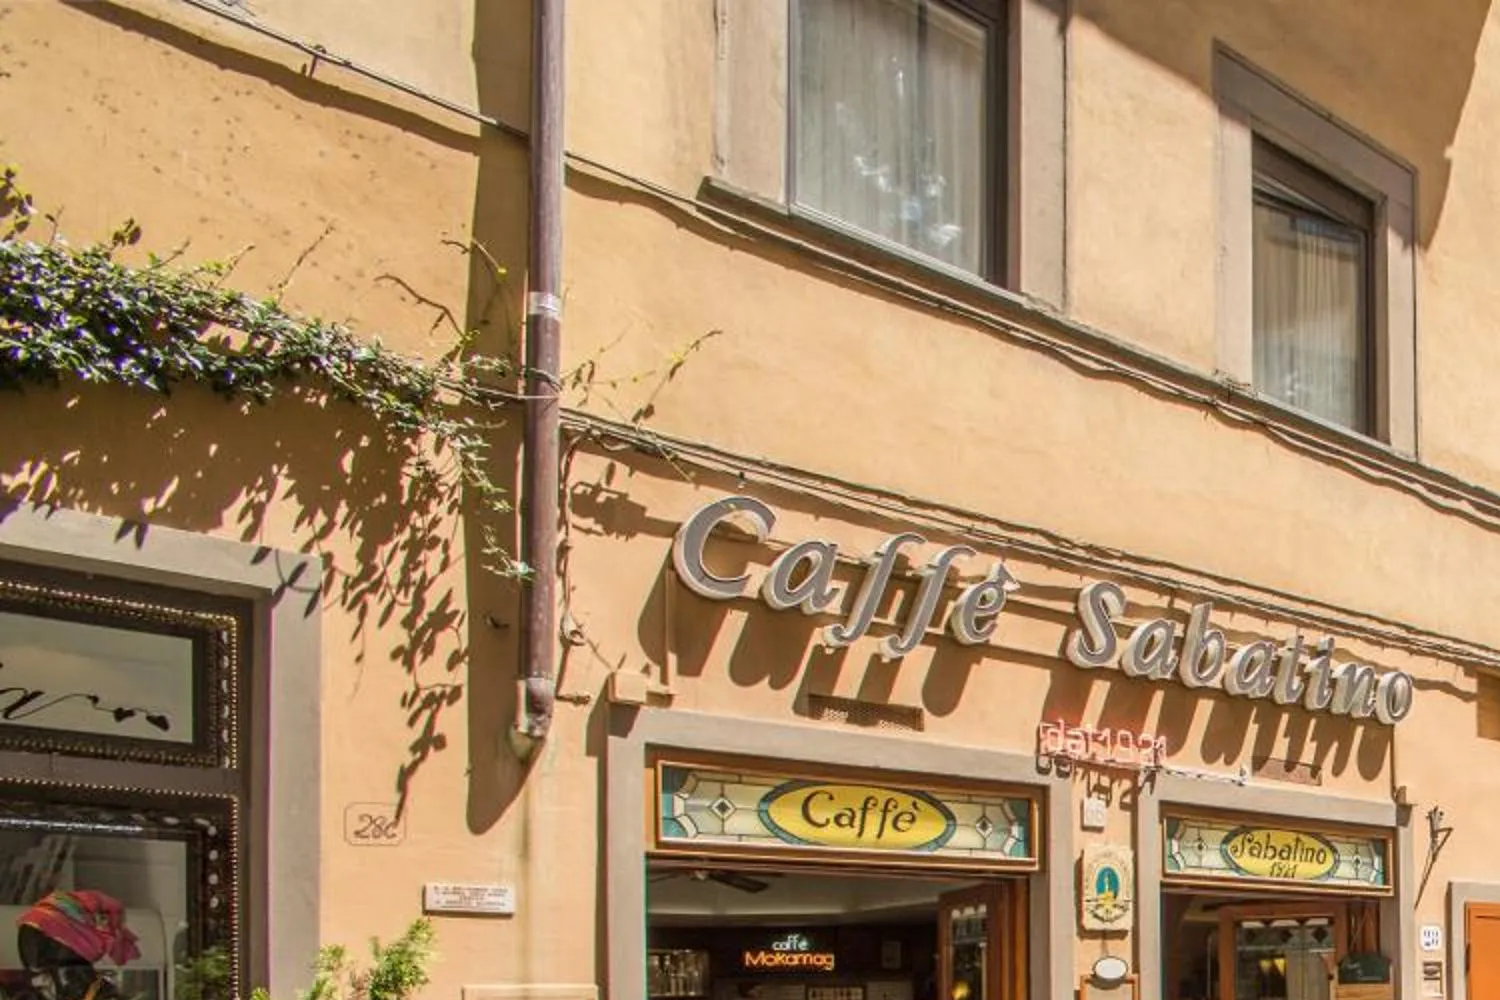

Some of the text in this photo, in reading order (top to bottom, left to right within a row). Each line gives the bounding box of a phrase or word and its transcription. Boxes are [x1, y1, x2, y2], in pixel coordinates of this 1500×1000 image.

[1065, 580, 1414, 725] Sabatino
[801, 789, 920, 840] Caffè
[1229, 832, 1328, 865] Sabatino
